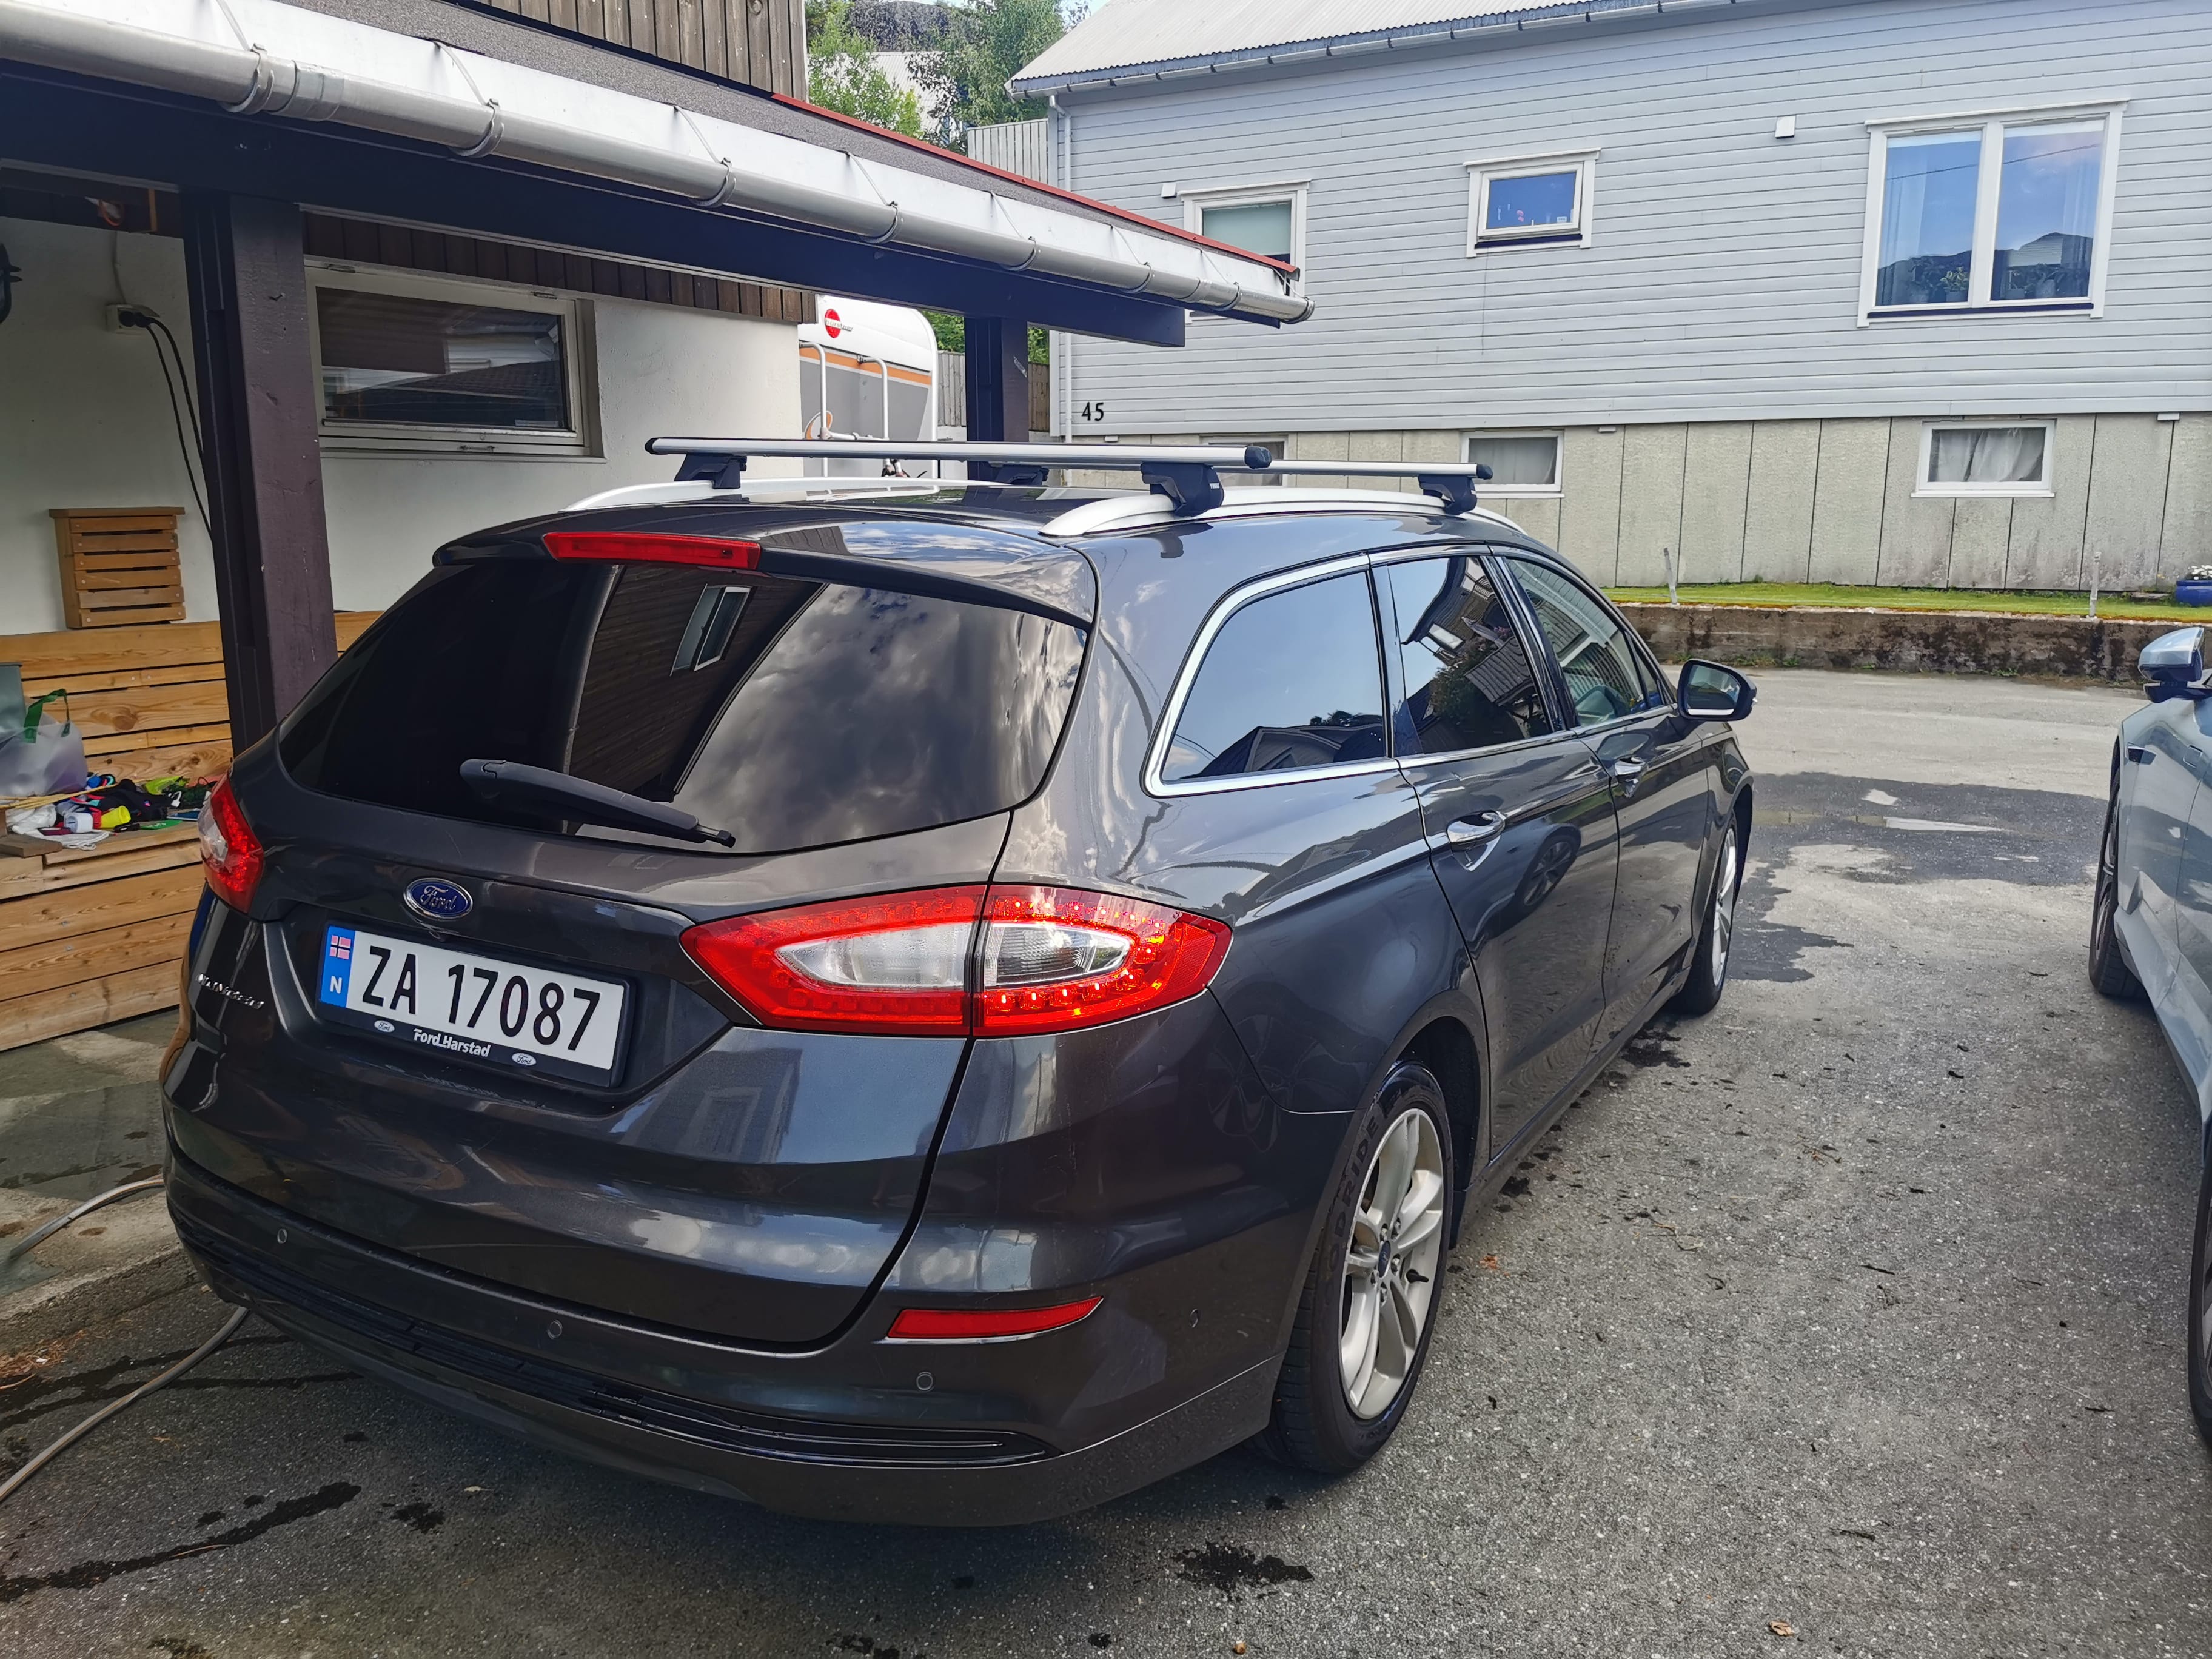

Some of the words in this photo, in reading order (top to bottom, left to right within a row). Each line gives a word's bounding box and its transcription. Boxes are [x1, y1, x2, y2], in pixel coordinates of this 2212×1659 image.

[1081, 401, 1104, 421] 45
[420, 885, 457, 910] Ford
[330, 976, 343, 994] N
[362, 945, 416, 1014] ZA
[448, 964, 601, 1051] 17087
